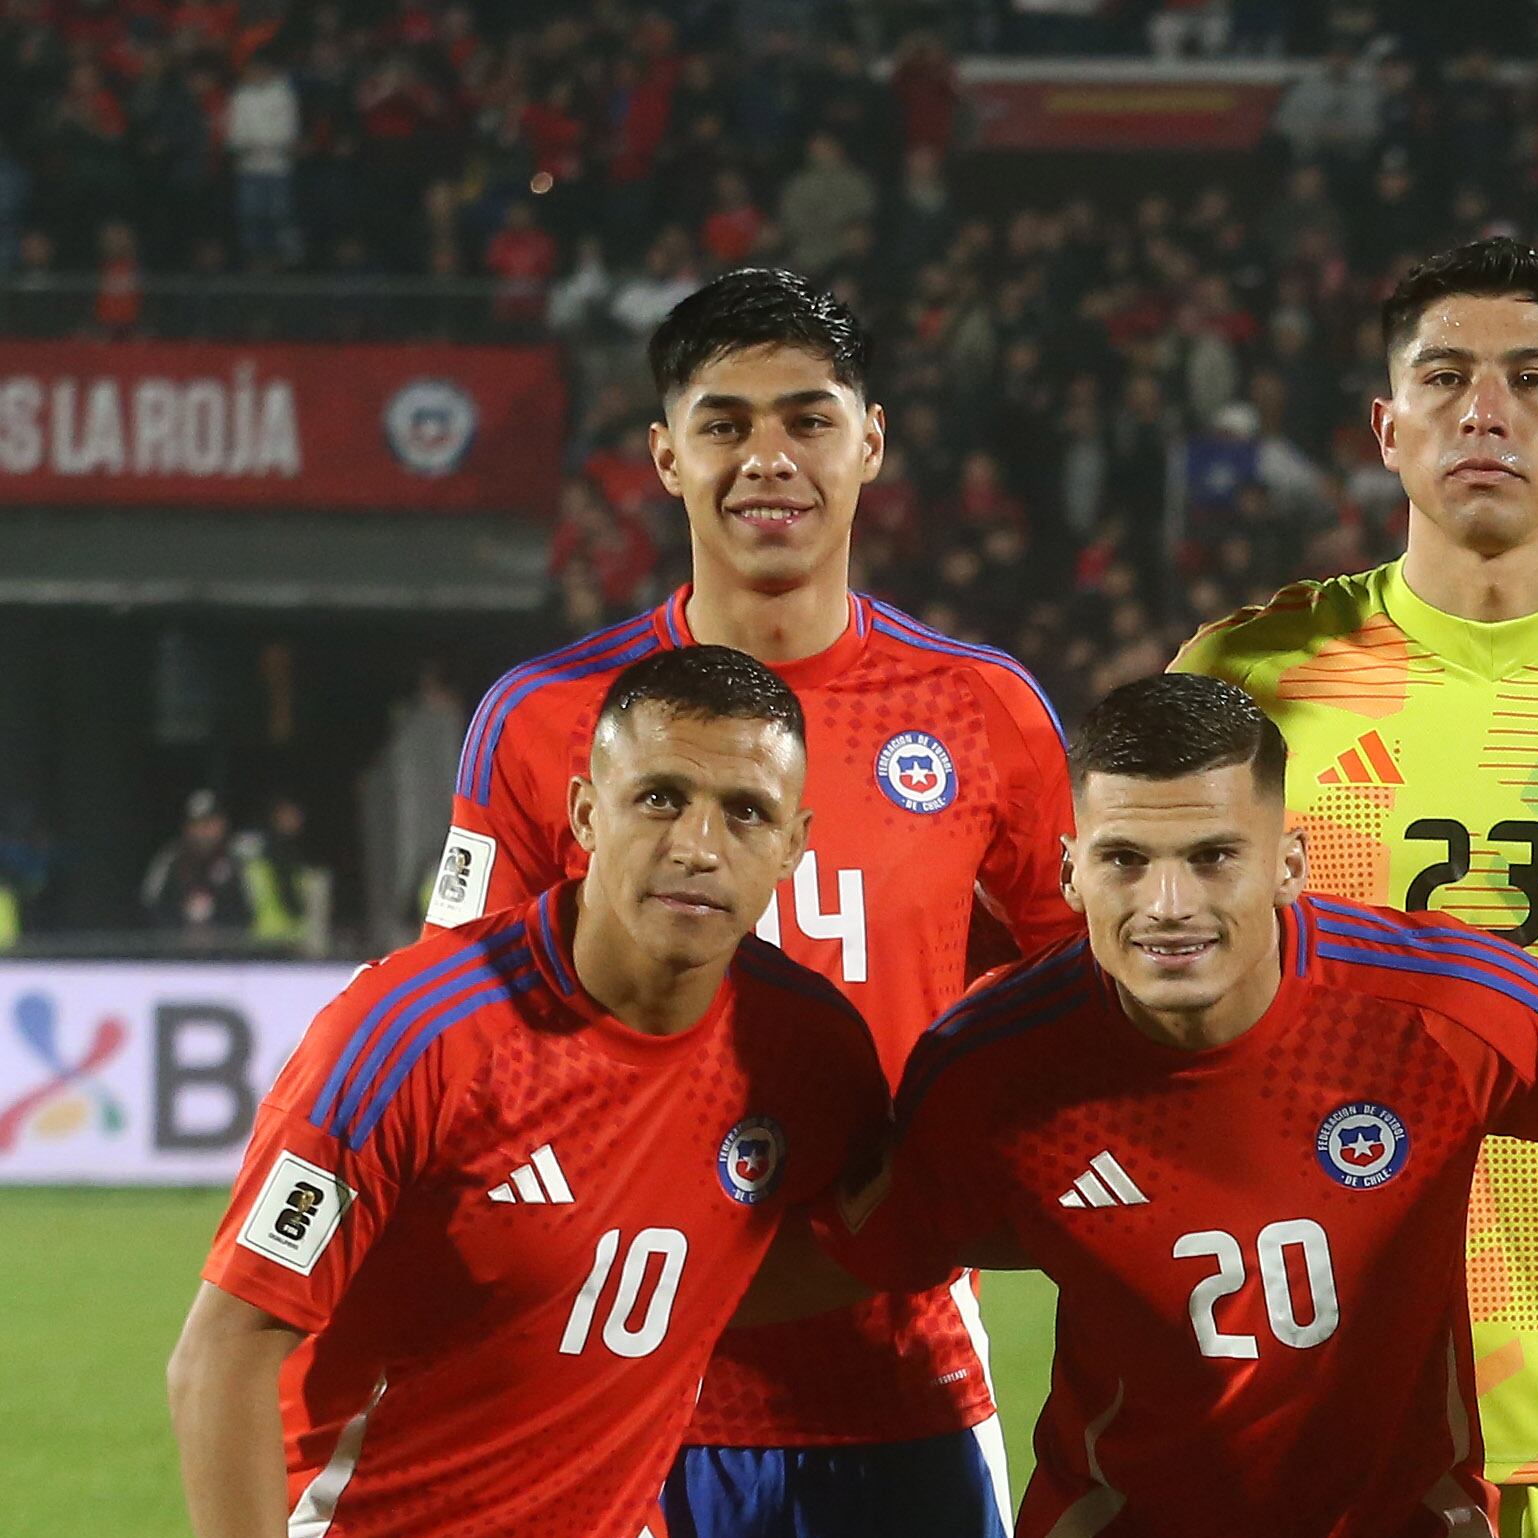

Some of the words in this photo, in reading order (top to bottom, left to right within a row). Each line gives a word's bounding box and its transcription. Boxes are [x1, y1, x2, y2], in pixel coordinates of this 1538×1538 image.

[52, 377, 124, 476] LA
[132, 360, 301, 477] ROJA
[559, 1228, 688, 1358] 10
[1172, 1218, 1340, 1359] 20
